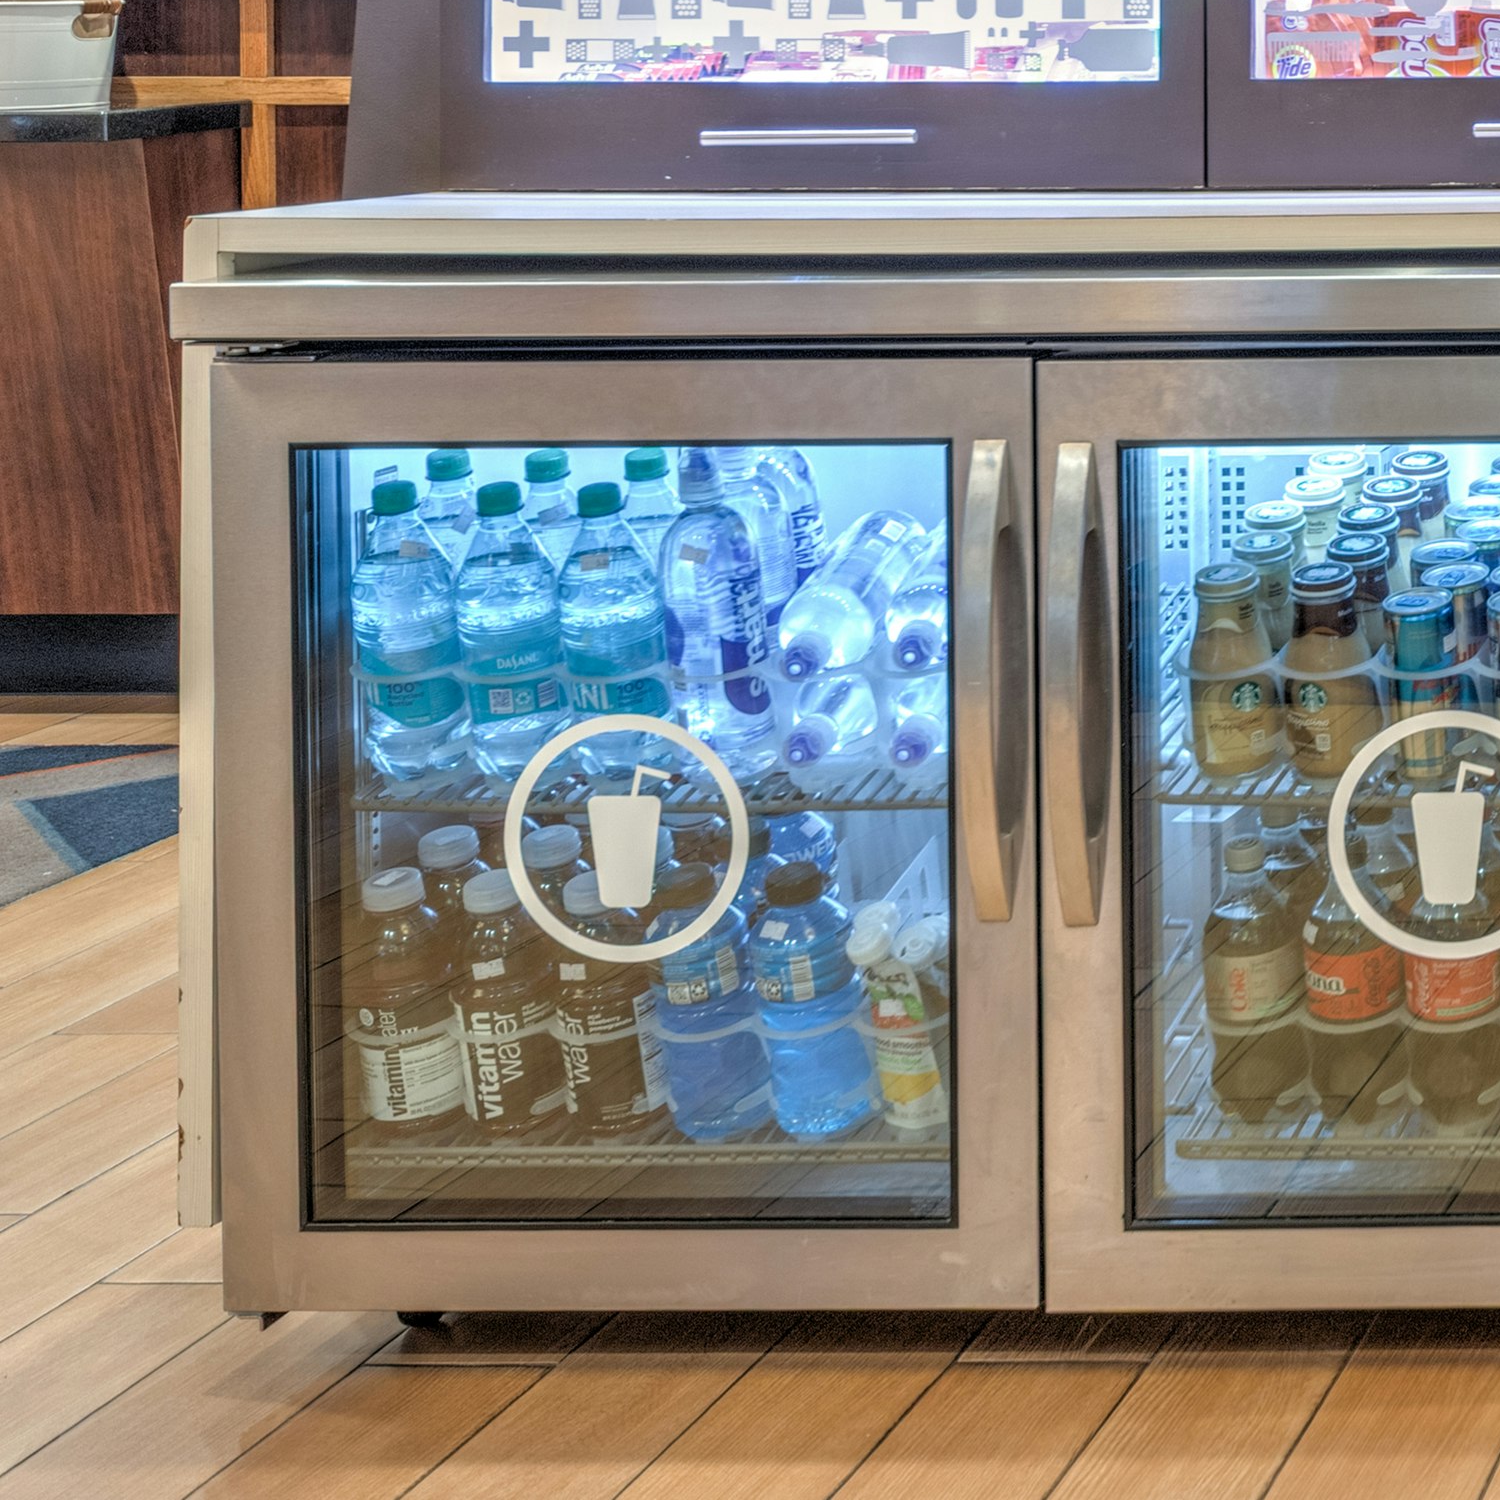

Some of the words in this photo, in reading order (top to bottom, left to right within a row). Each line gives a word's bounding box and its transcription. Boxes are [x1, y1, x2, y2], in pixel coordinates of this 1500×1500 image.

[1278, 56, 1311, 79] Tide
[468, 1011, 505, 1120] vitamin
[493, 1010, 524, 1084] water
